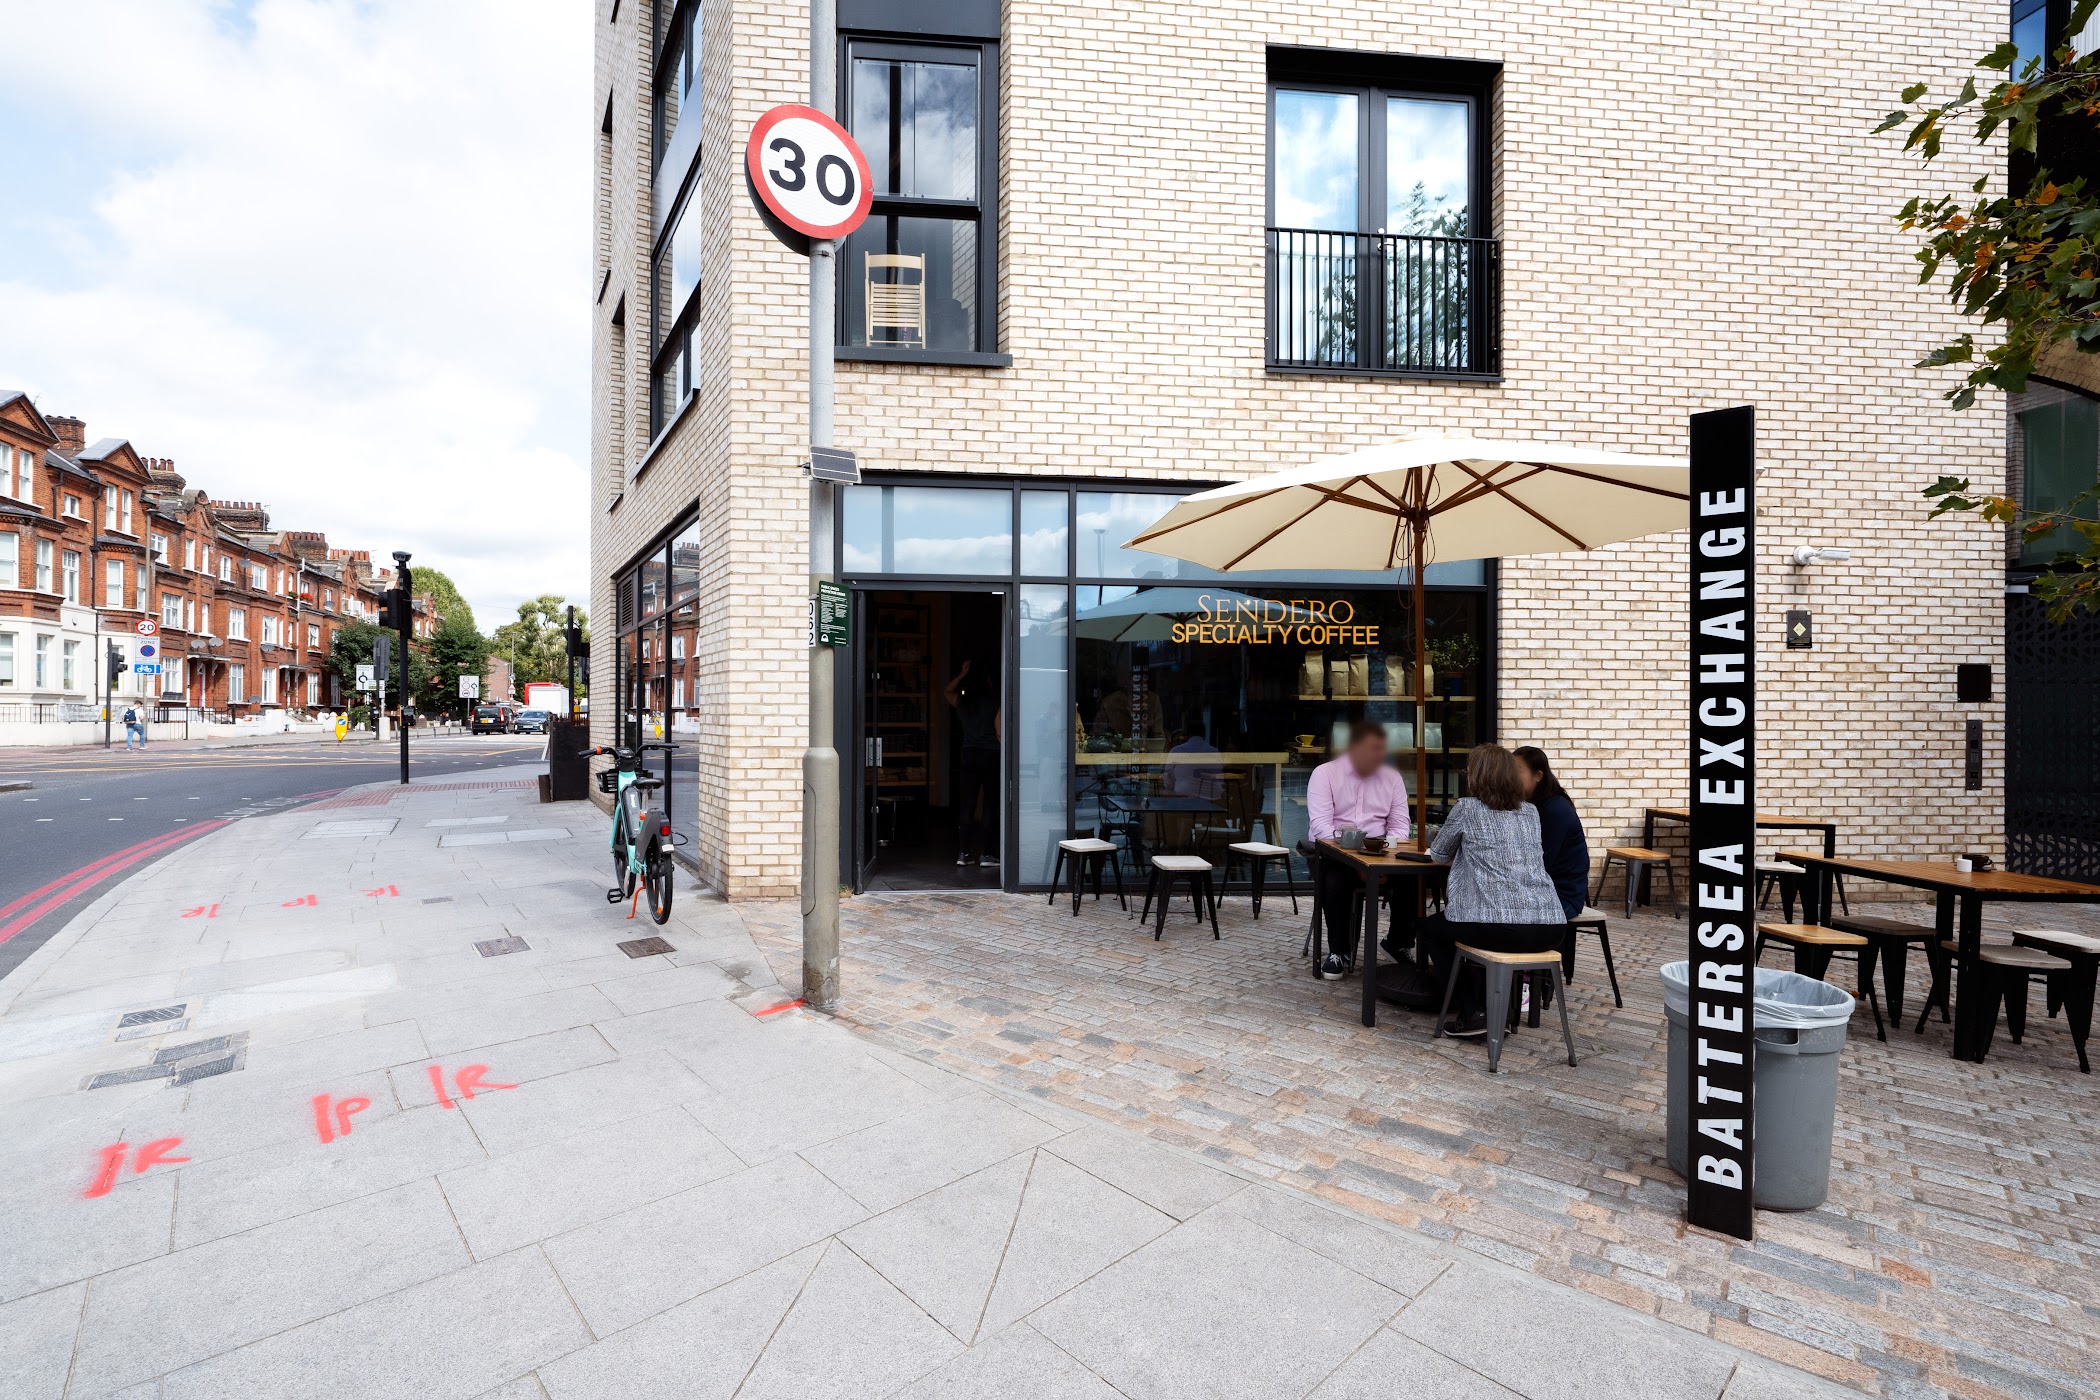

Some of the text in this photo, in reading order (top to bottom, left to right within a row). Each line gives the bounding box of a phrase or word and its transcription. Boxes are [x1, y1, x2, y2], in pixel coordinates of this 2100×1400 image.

[768, 137, 856, 206] 30
[1196, 594, 1355, 624] SENDERO
[139, 623, 155, 631] 20
[1171, 622, 1380, 646] SPECIALTY COFFEE
[1697, 487, 1746, 1191] BATTERSEA EXCHANGE
